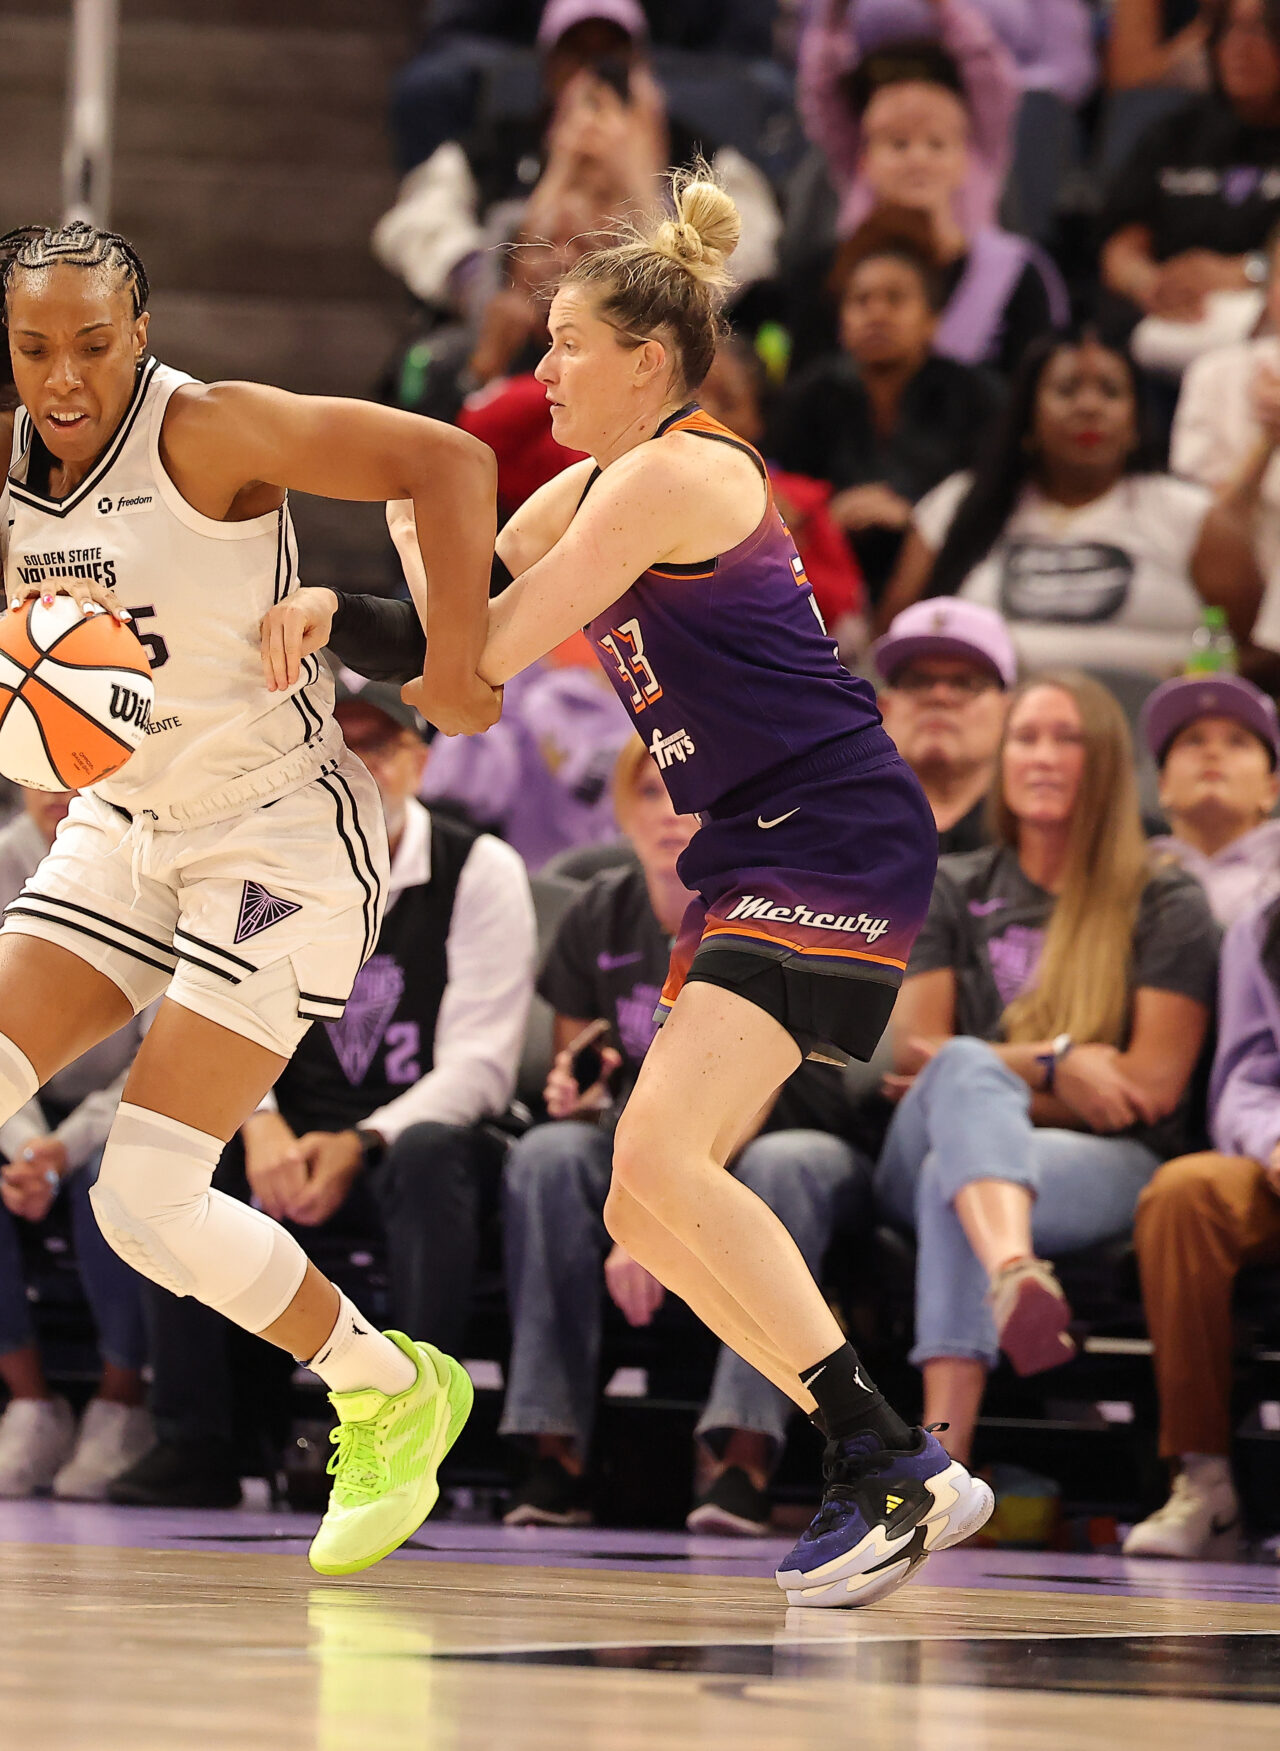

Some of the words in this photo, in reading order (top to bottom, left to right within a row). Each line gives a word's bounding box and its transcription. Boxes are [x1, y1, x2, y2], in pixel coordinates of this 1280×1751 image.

[117, 495, 152, 511] freedom
[24, 550, 65, 566] GOLDEN
[69, 547, 102, 563] STATE
[598, 617, 663, 714] 33
[109, 683, 151, 732] Wil
[725, 895, 890, 944] Mercury
[384, 1021, 421, 1085] 2
